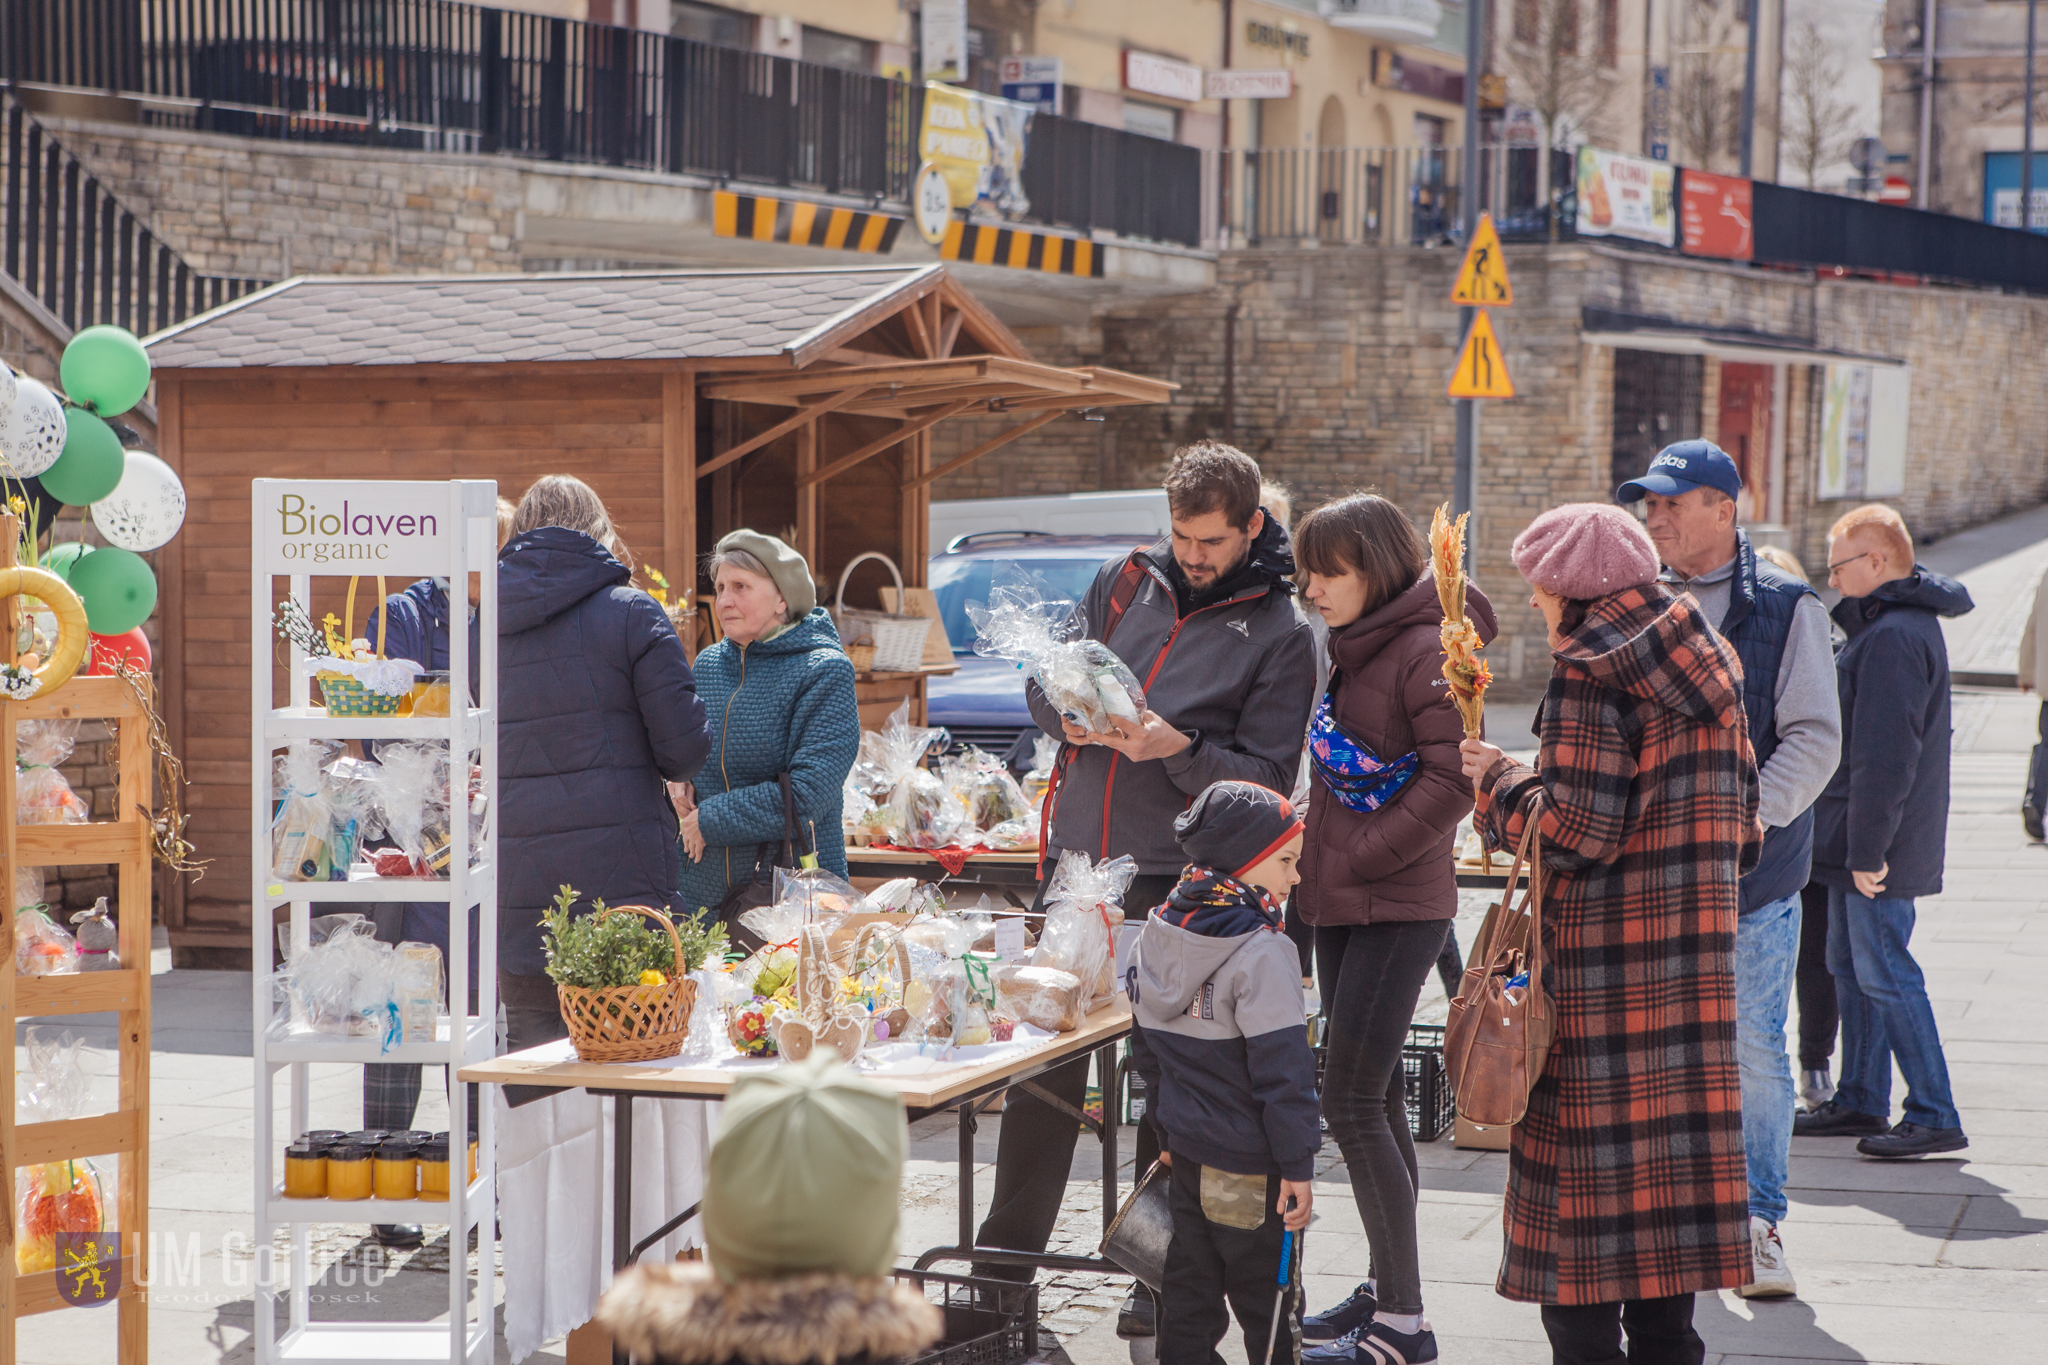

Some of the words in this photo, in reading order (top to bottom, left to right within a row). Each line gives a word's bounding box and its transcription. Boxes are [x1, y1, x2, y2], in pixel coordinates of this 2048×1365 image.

[277, 494, 437, 536] Biolaven
[282, 542, 389, 563] organic
[1204, 986, 1212, 1017] EVERY
